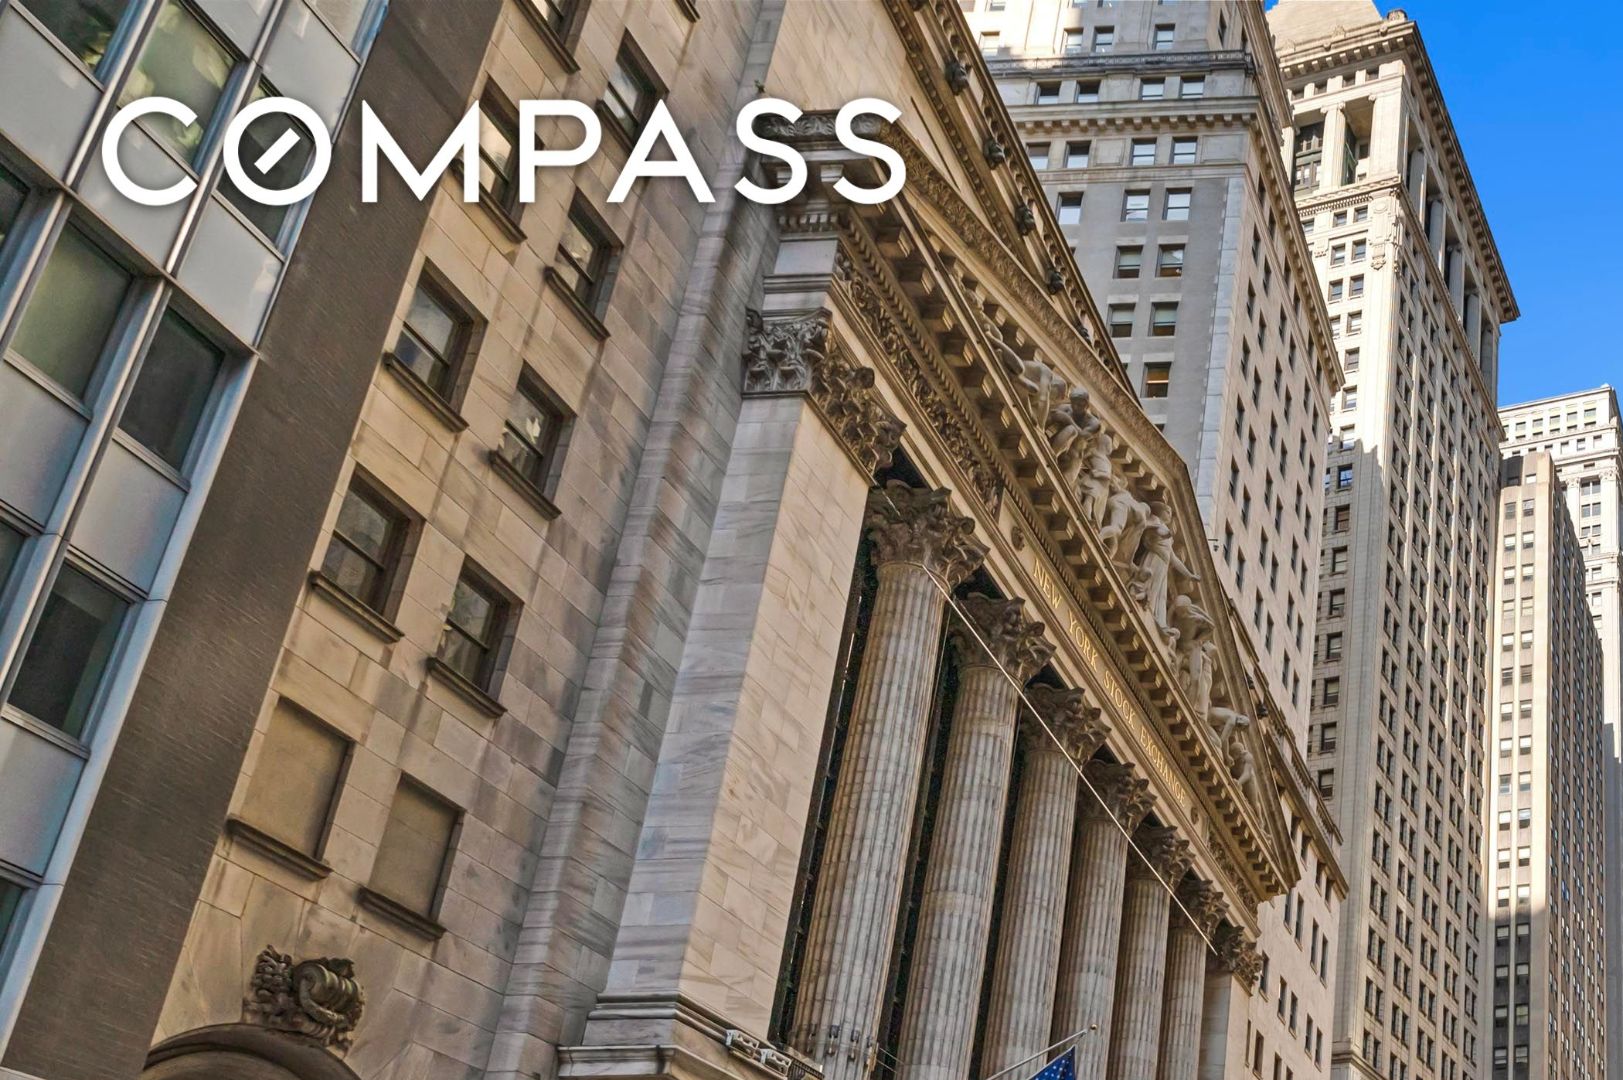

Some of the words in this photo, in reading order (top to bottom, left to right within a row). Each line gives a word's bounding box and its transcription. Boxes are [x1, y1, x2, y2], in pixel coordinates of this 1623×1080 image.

[1034, 559, 1062, 609] NEW
[1068, 607, 1098, 673] YORK
[1103, 670, 1136, 730] STOCK
[1140, 726, 1186, 808] EXCHANGE
